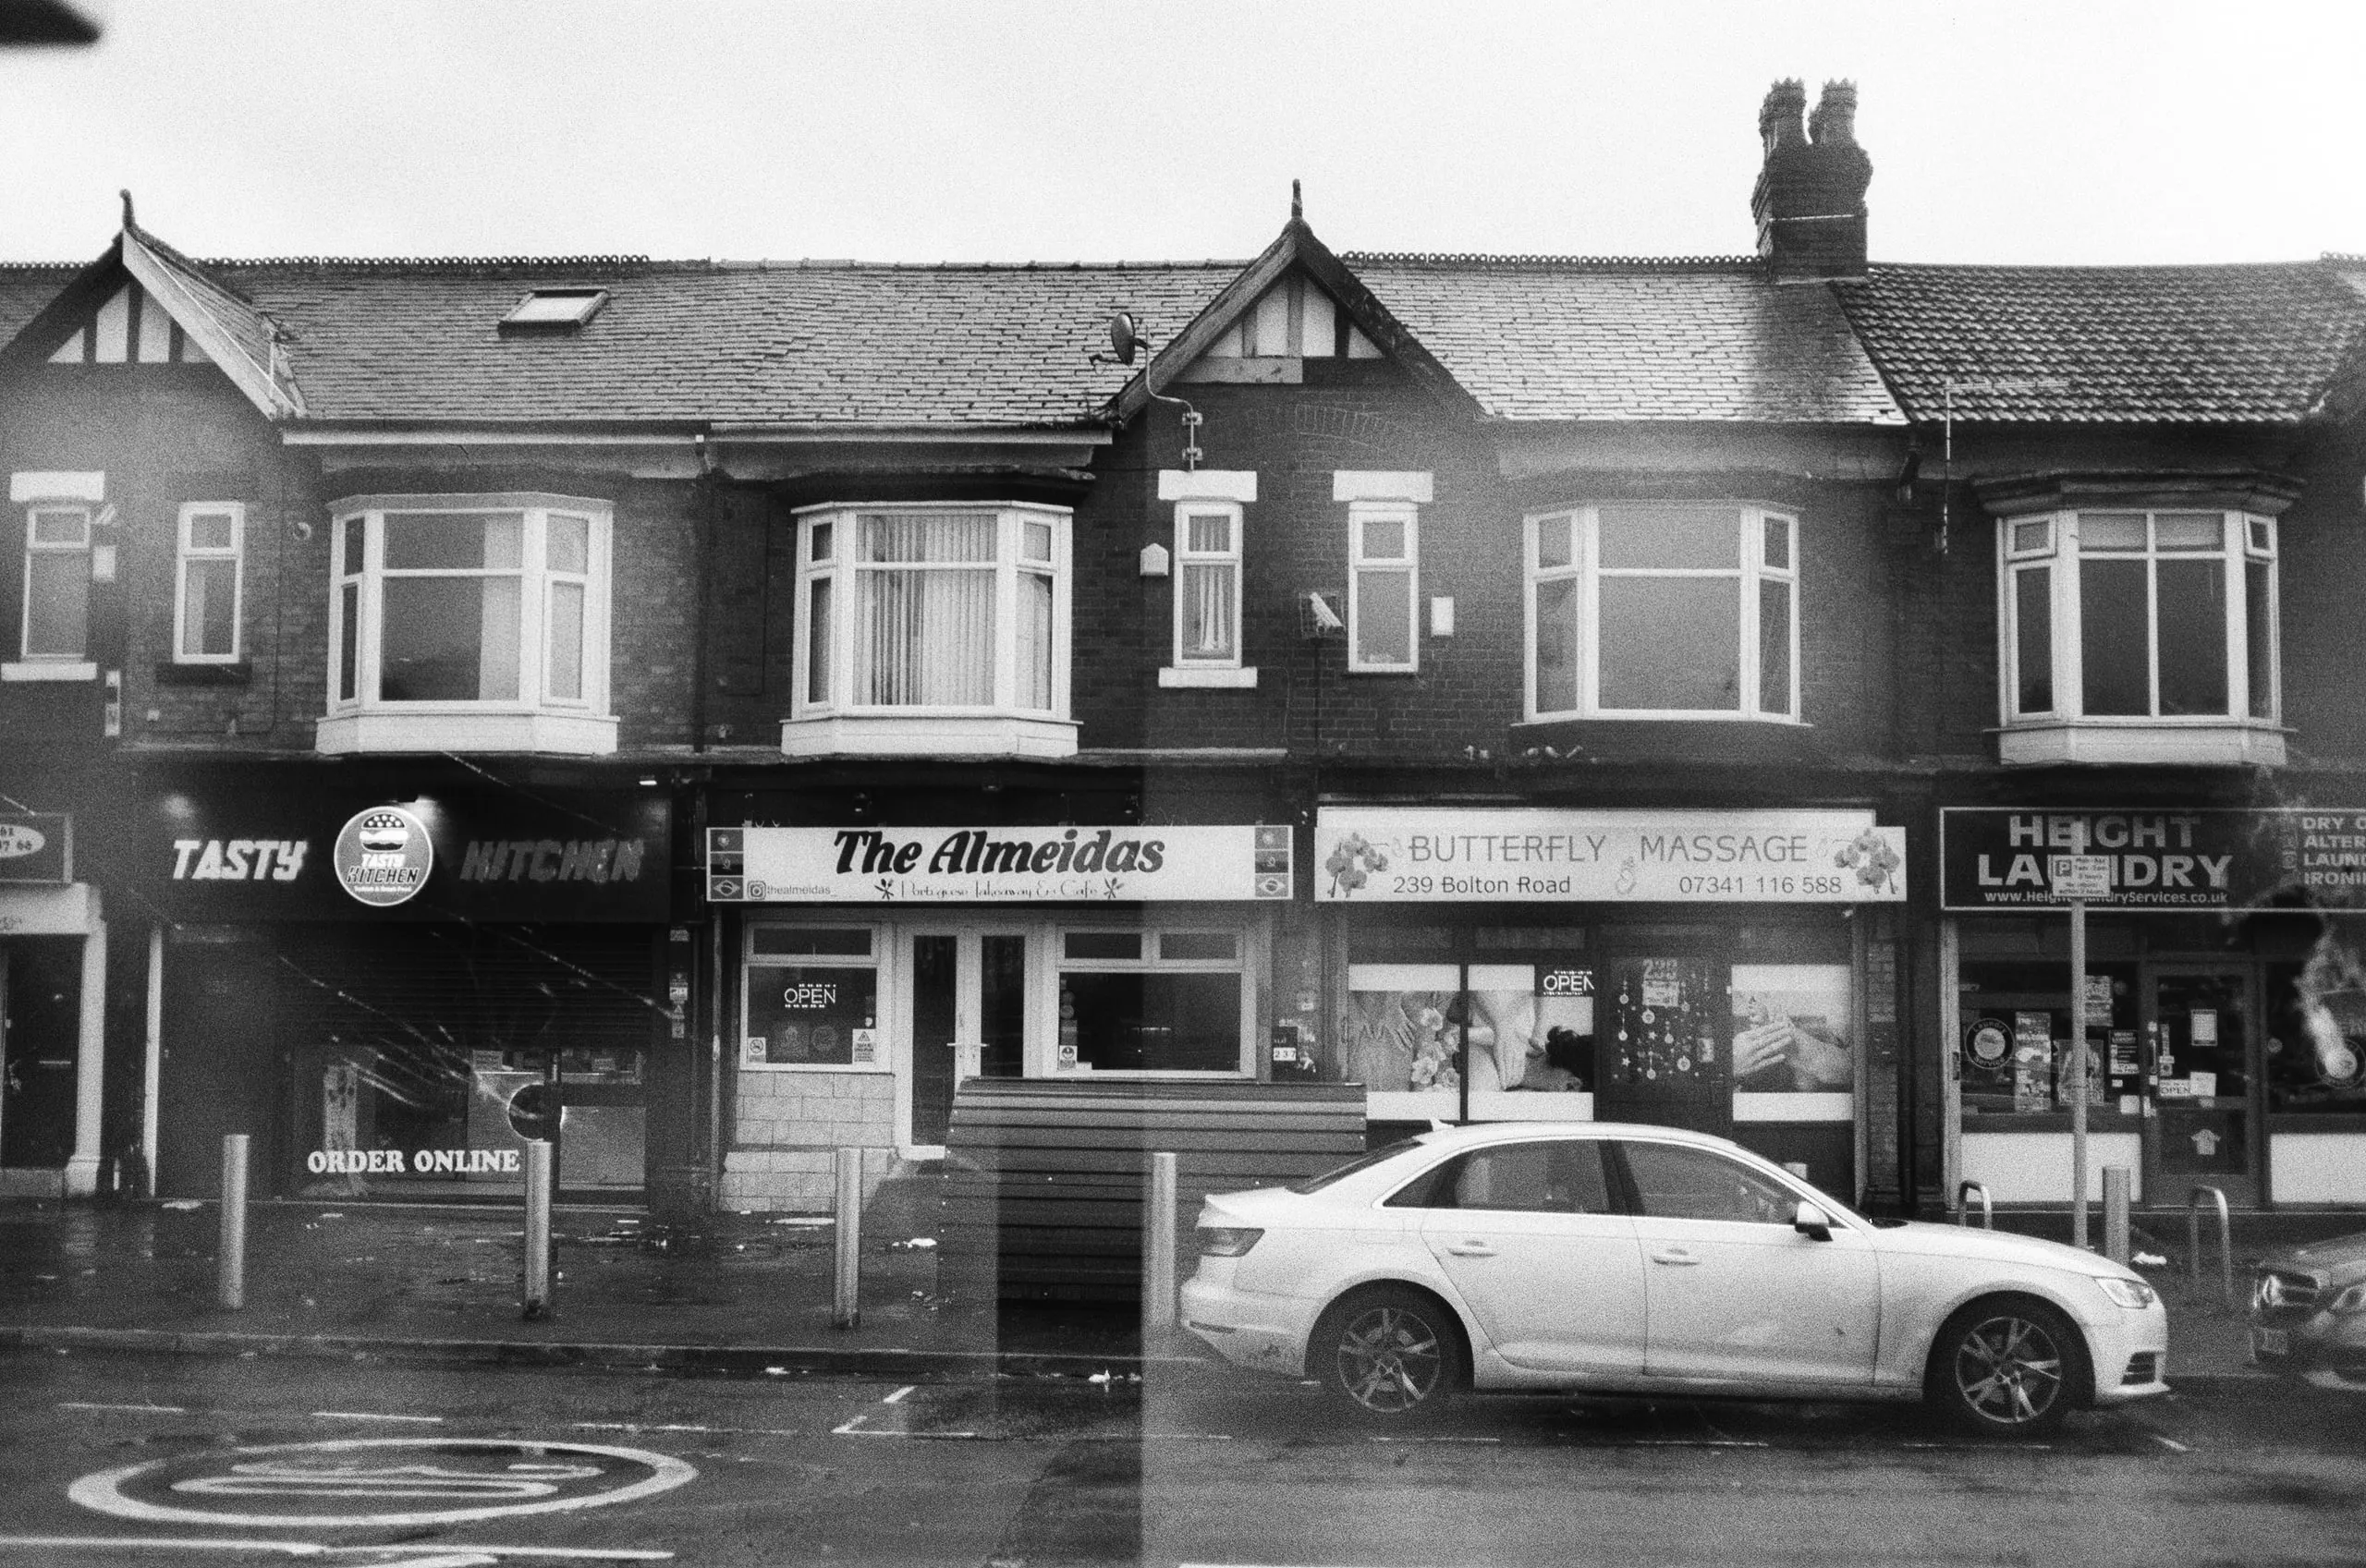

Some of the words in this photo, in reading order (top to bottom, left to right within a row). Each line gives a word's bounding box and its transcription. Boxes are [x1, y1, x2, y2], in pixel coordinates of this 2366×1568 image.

[2009, 815, 2201, 847] HEIGHT
[2302, 817, 2343, 830] DRY
[834, 830, 922, 874] The
[929, 829, 1165, 874] Almeidas
[1409, 835, 1606, 862] BUTTERFLY
[1640, 835, 1808, 862] MASSAGE
[173, 839, 308, 880] TASTY
[459, 839, 644, 882] KITCHEN
[361, 853, 406, 868] TASTY
[2058, 861, 2069, 875] P
[347, 866, 420, 883] KITCHEN
[1978, 854, 2234, 887] LADRY
[1393, 876, 1433, 893] 239
[1442, 876, 1508, 893] Bolton
[1517, 875, 1570, 893] Road
[1679, 876, 1743, 893] 07341
[1756, 876, 1794, 893] 116
[1802, 876, 1842, 893] 588
[1543, 976, 1594, 991] OPEN
[784, 988, 835, 1003] OPEN
[308, 1149, 405, 1173] ORDER
[414, 1149, 519, 1173] ONLINE
